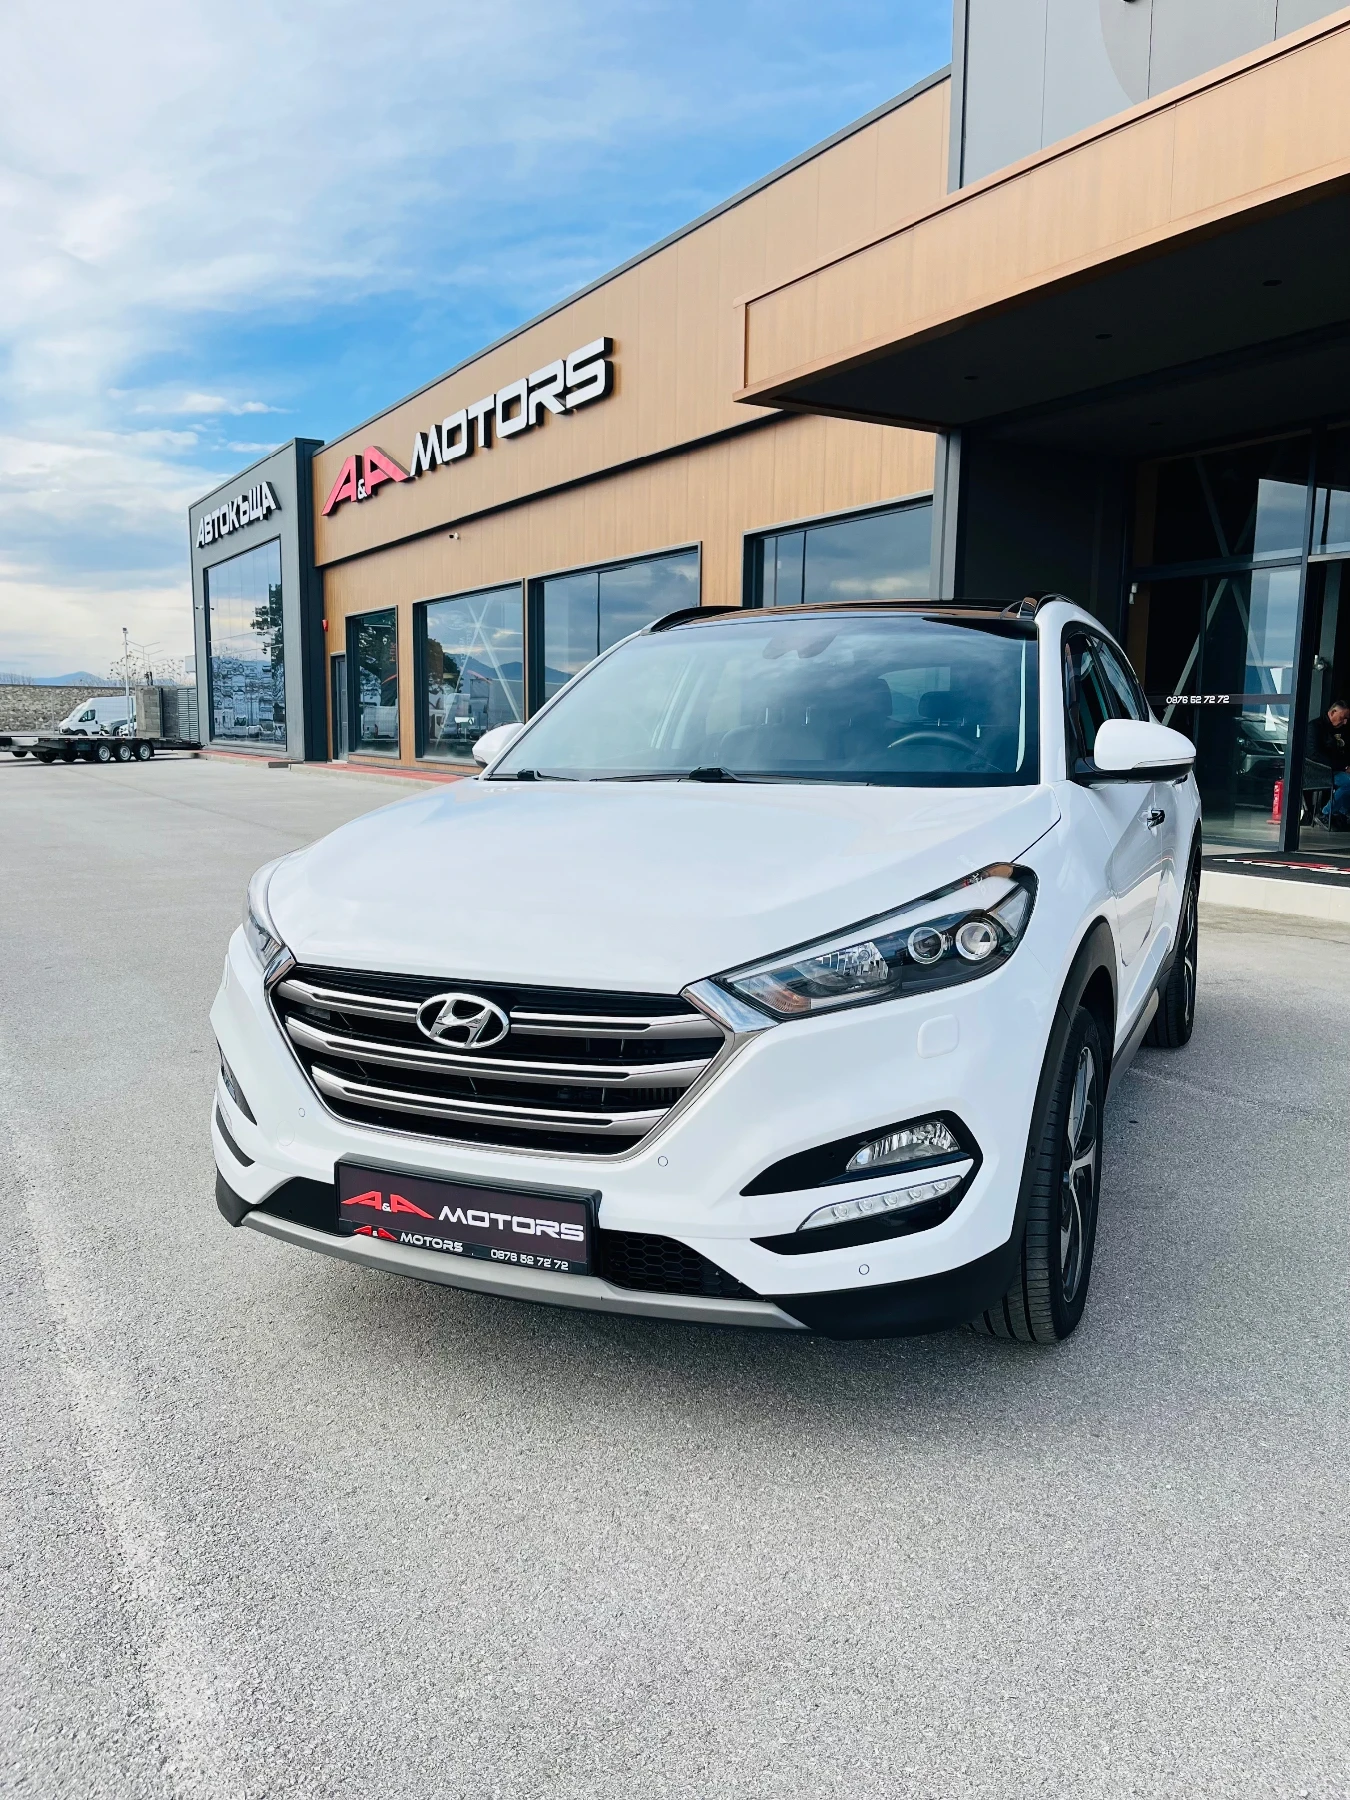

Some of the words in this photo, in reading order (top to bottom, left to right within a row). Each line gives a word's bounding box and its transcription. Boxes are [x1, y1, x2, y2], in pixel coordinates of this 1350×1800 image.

[321, 445, 413, 516] A&A
[410, 336, 613, 477] MOTORS
[196, 481, 281, 548] АВТОКЪЩА
[1166, 695, 1188, 704] 0876
[1203, 695, 1215, 704] 72
[1217, 694, 1230, 704] 72
[341, 1190, 435, 1220] A&A
[438, 1205, 585, 1242] MOTORS
[400, 1232, 464, 1253] MOTORS
[520, 1253, 535, 1265] 52
[536, 1257, 552, 1268] 72
[553, 1259, 569, 1271] 72
